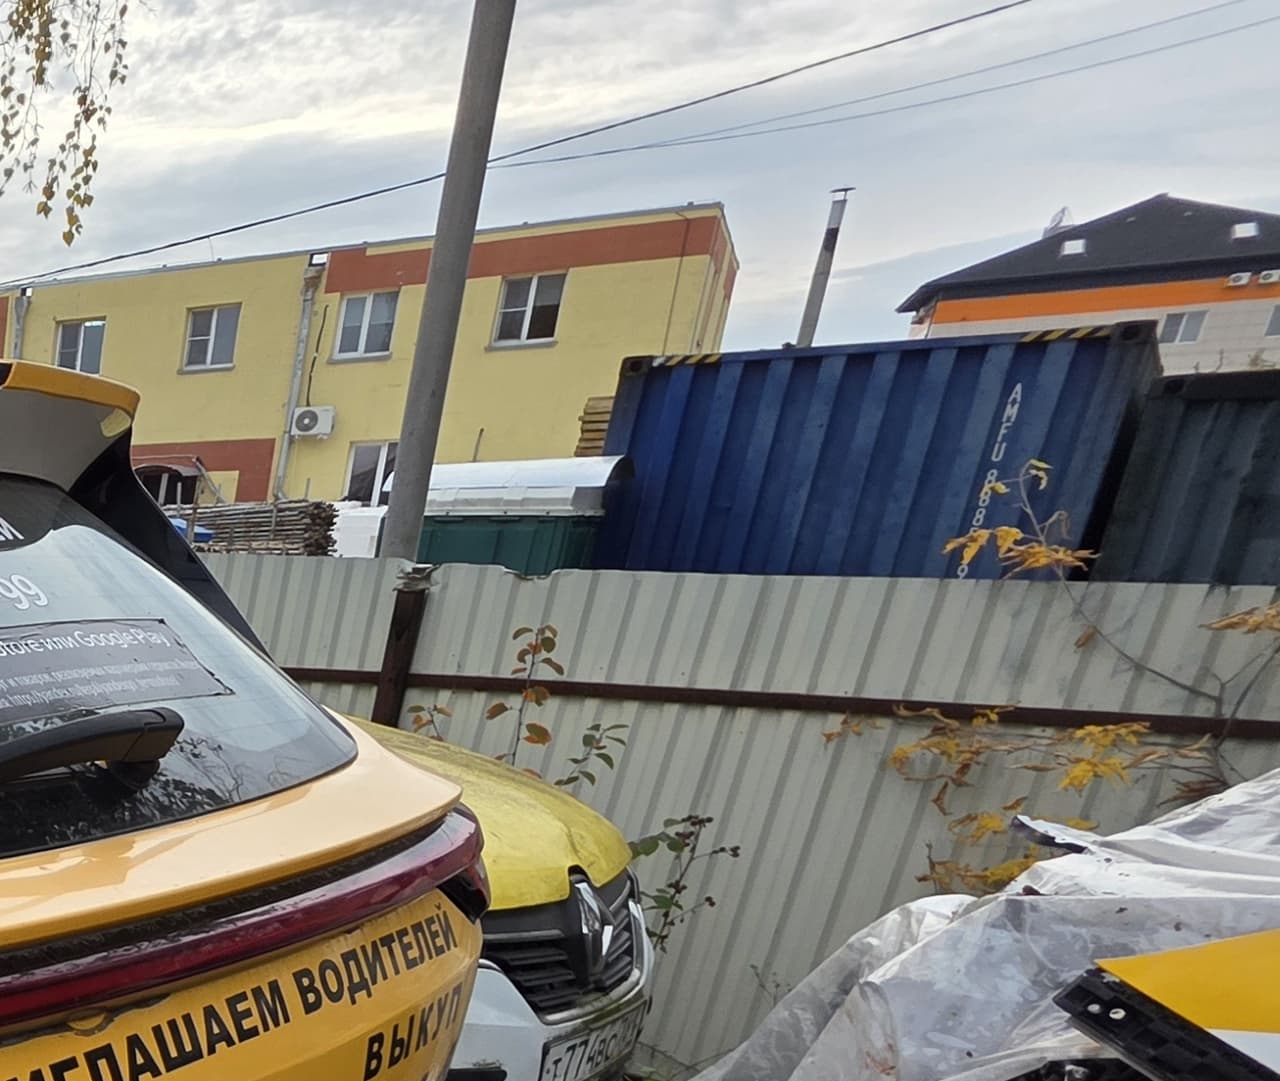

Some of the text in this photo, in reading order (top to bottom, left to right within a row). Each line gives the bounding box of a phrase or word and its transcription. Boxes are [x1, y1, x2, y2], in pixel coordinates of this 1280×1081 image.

[992, 382, 1022, 461] AMFU
[42, 636, 78, 651] или
[74, 629, 140, 649] Google
[130, 628, 172, 647] Play
[297, 906, 458, 1016] ВОДИТЕЛЕЙ
